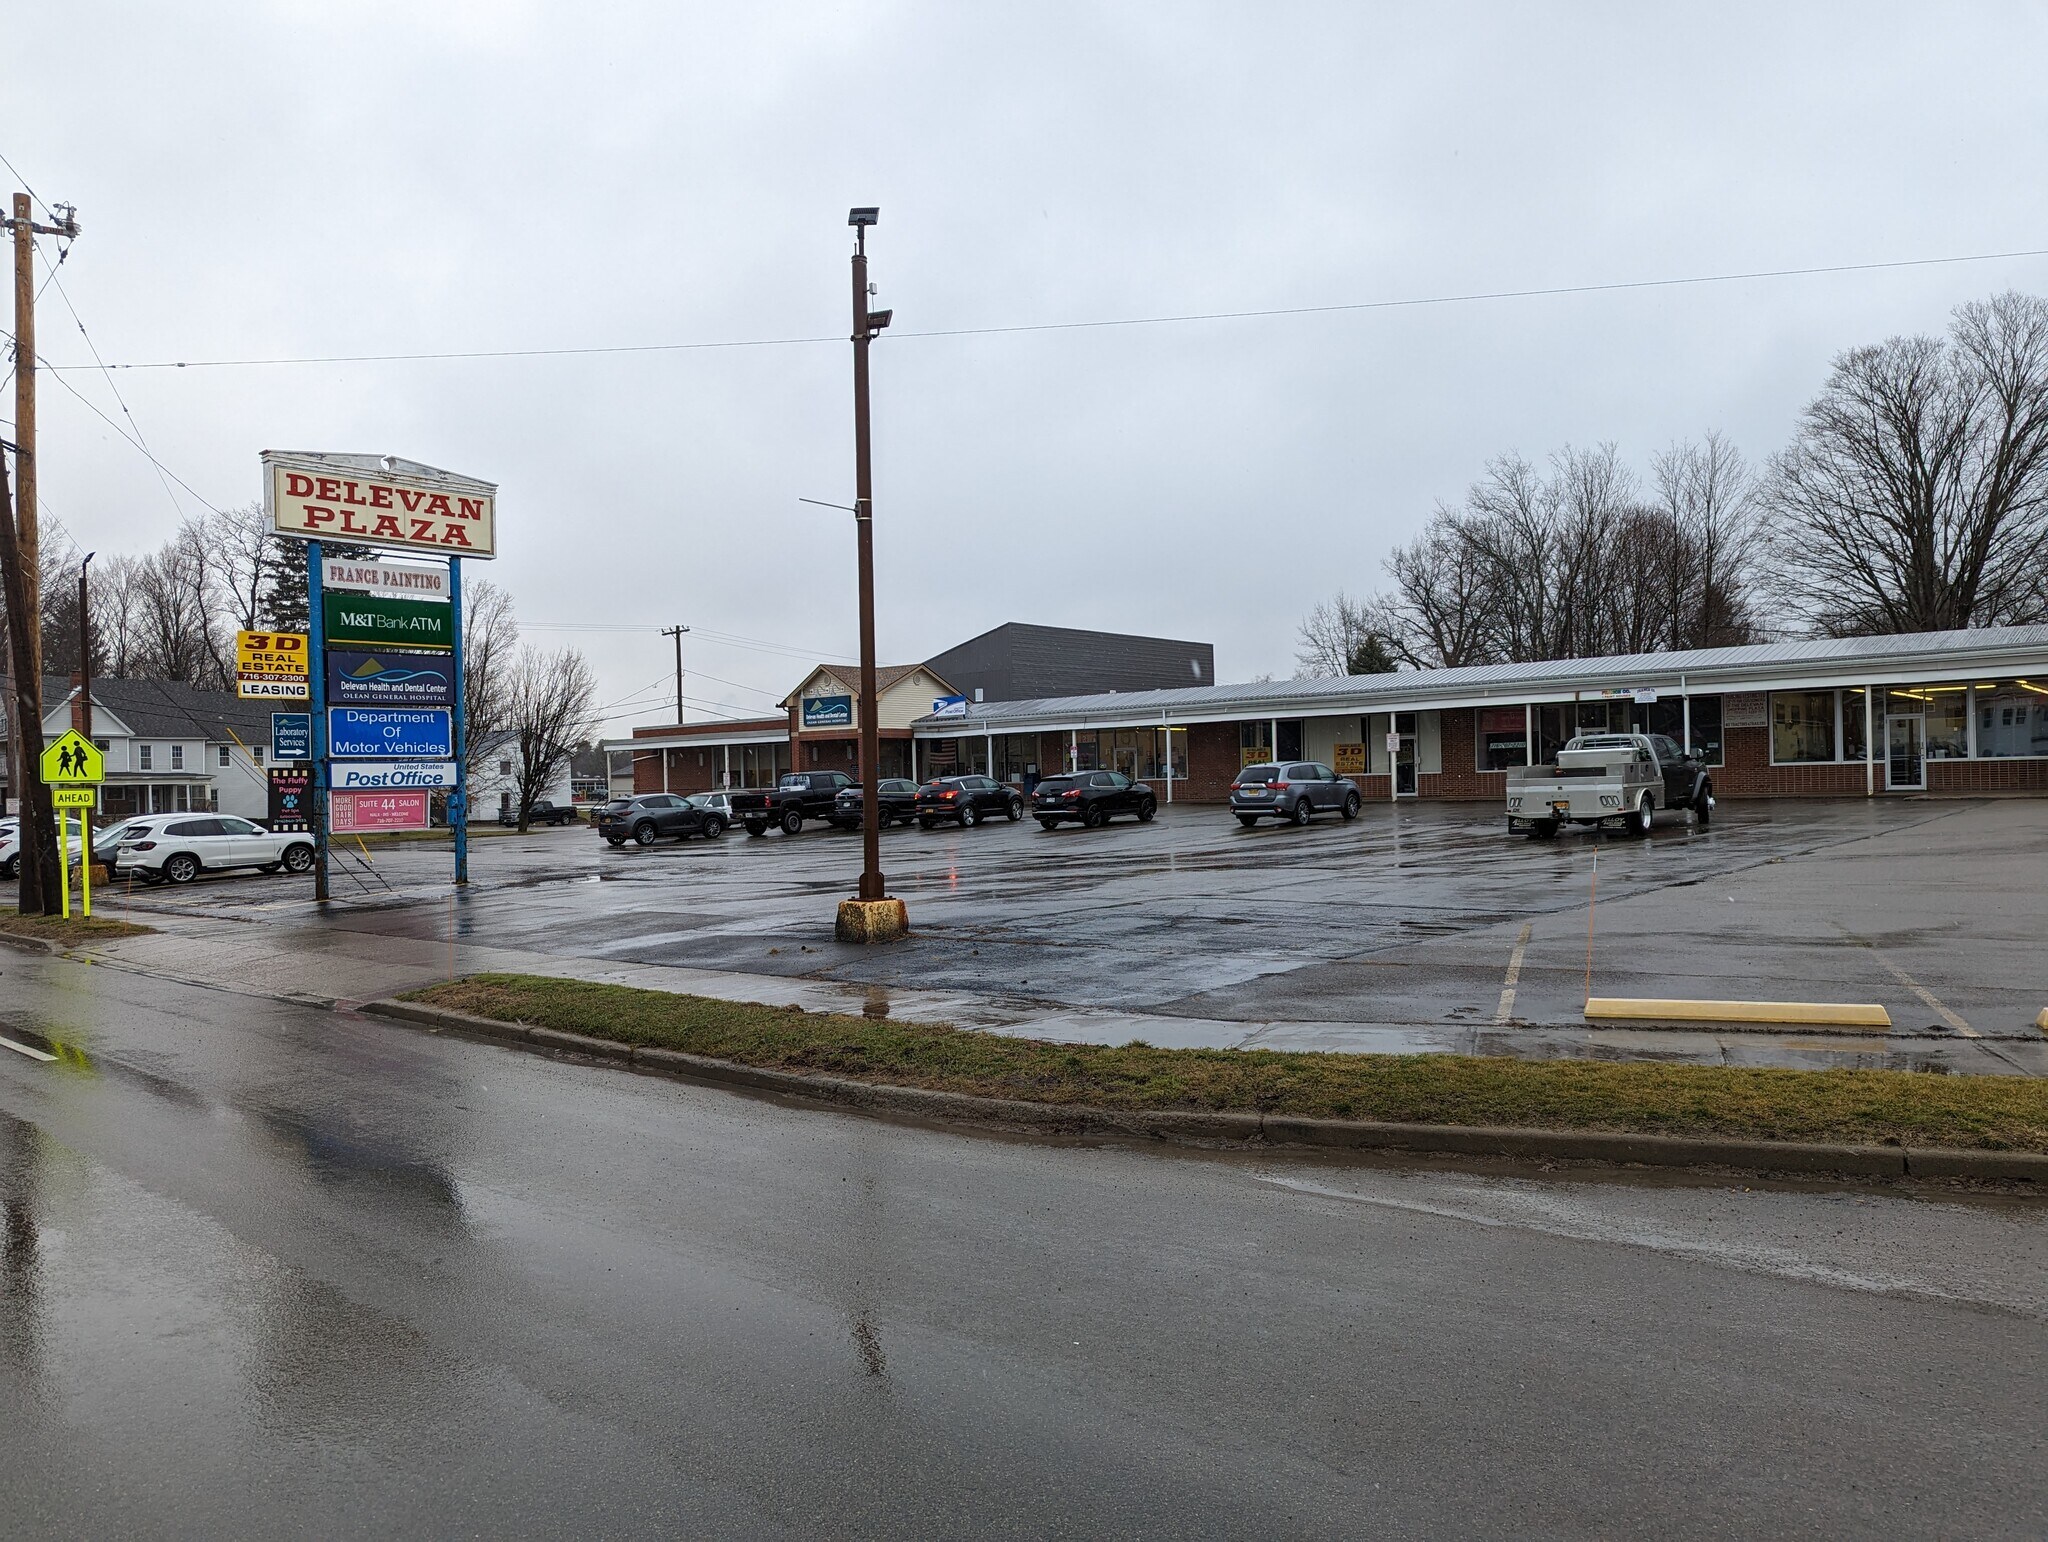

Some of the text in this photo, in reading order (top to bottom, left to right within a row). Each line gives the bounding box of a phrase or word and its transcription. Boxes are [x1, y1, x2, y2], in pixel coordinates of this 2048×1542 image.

[286, 473, 484, 520] DELEVAN
[303, 505, 472, 546] PLAZA
[330, 566, 441, 590] FRANCE PAINTING
[340, 612, 441, 631] M&T Bank ATM
[252, 653, 296, 662] REAL
[242, 662, 304, 672] ESTATE
[243, 673, 304, 681] 716-307-2300
[243, 685, 306, 695] LEASING
[341, 681, 447, 693] Delevan Health and Dental Center
[347, 711, 435, 724] Department
[275, 727, 308, 738] Laboratory
[383, 726, 401, 738] Of
[280, 738, 305, 746] Services
[336, 741, 446, 753] Motor Vehicles
[288, 777, 308, 785] Fluffy
[346, 771, 444, 786] Post Office
[58, 794, 90, 802] AHEAD
[381, 799, 396, 810] 44
[335, 818, 352, 826] DAYS
